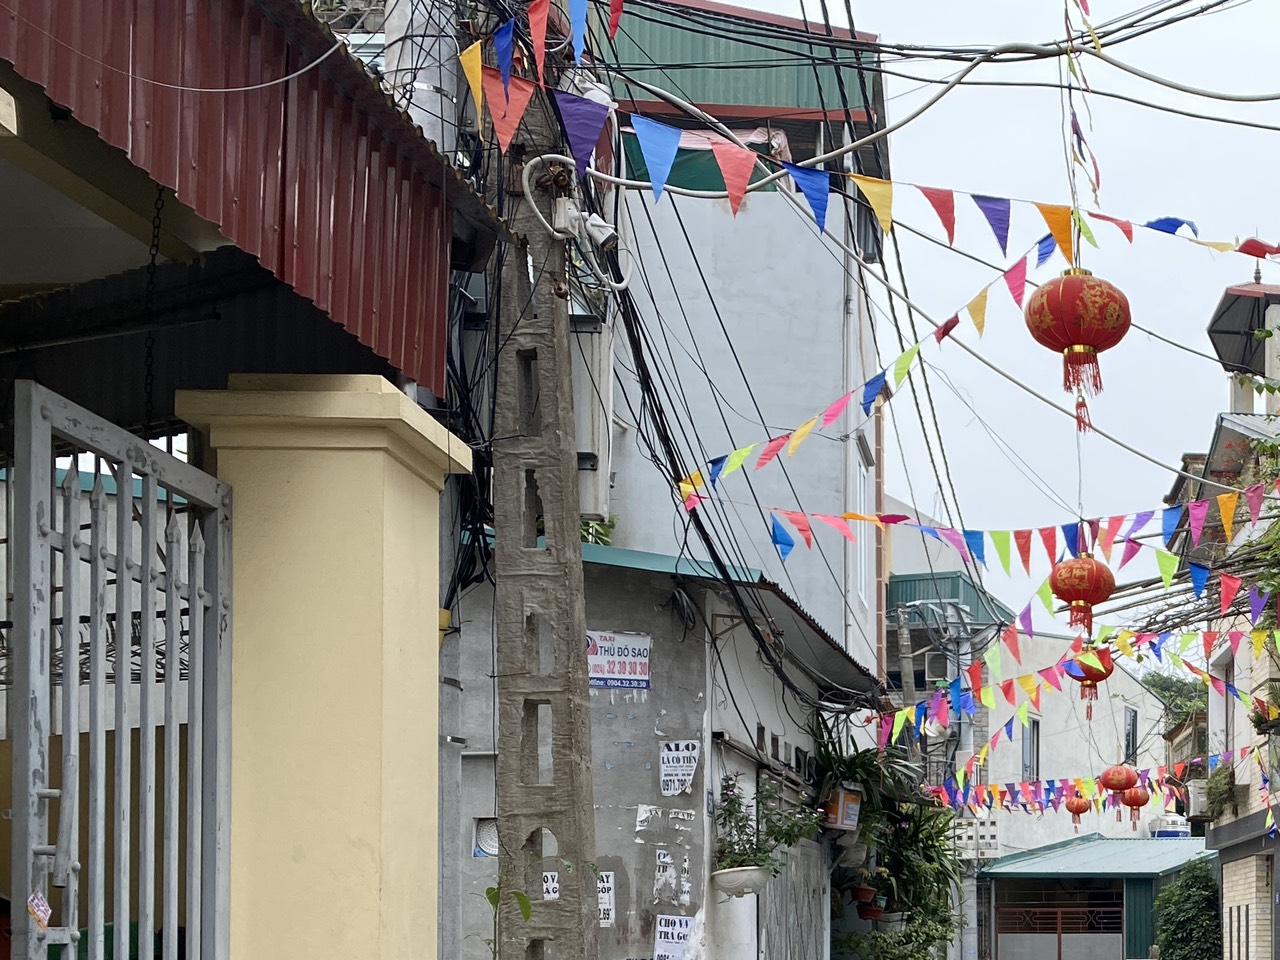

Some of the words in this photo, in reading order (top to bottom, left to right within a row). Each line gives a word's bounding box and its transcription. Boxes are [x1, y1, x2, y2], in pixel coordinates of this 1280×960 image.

[599, 635, 615, 643] TAXI
[599, 642, 615, 657] THỦ
[631, 647, 649, 659] SAO
[606, 659, 616, 674] 32
[617, 660, 627, 675] 30
[628, 661, 637, 676] 30
[638, 661, 648, 676] 30
[663, 742, 697, 753] ALO
